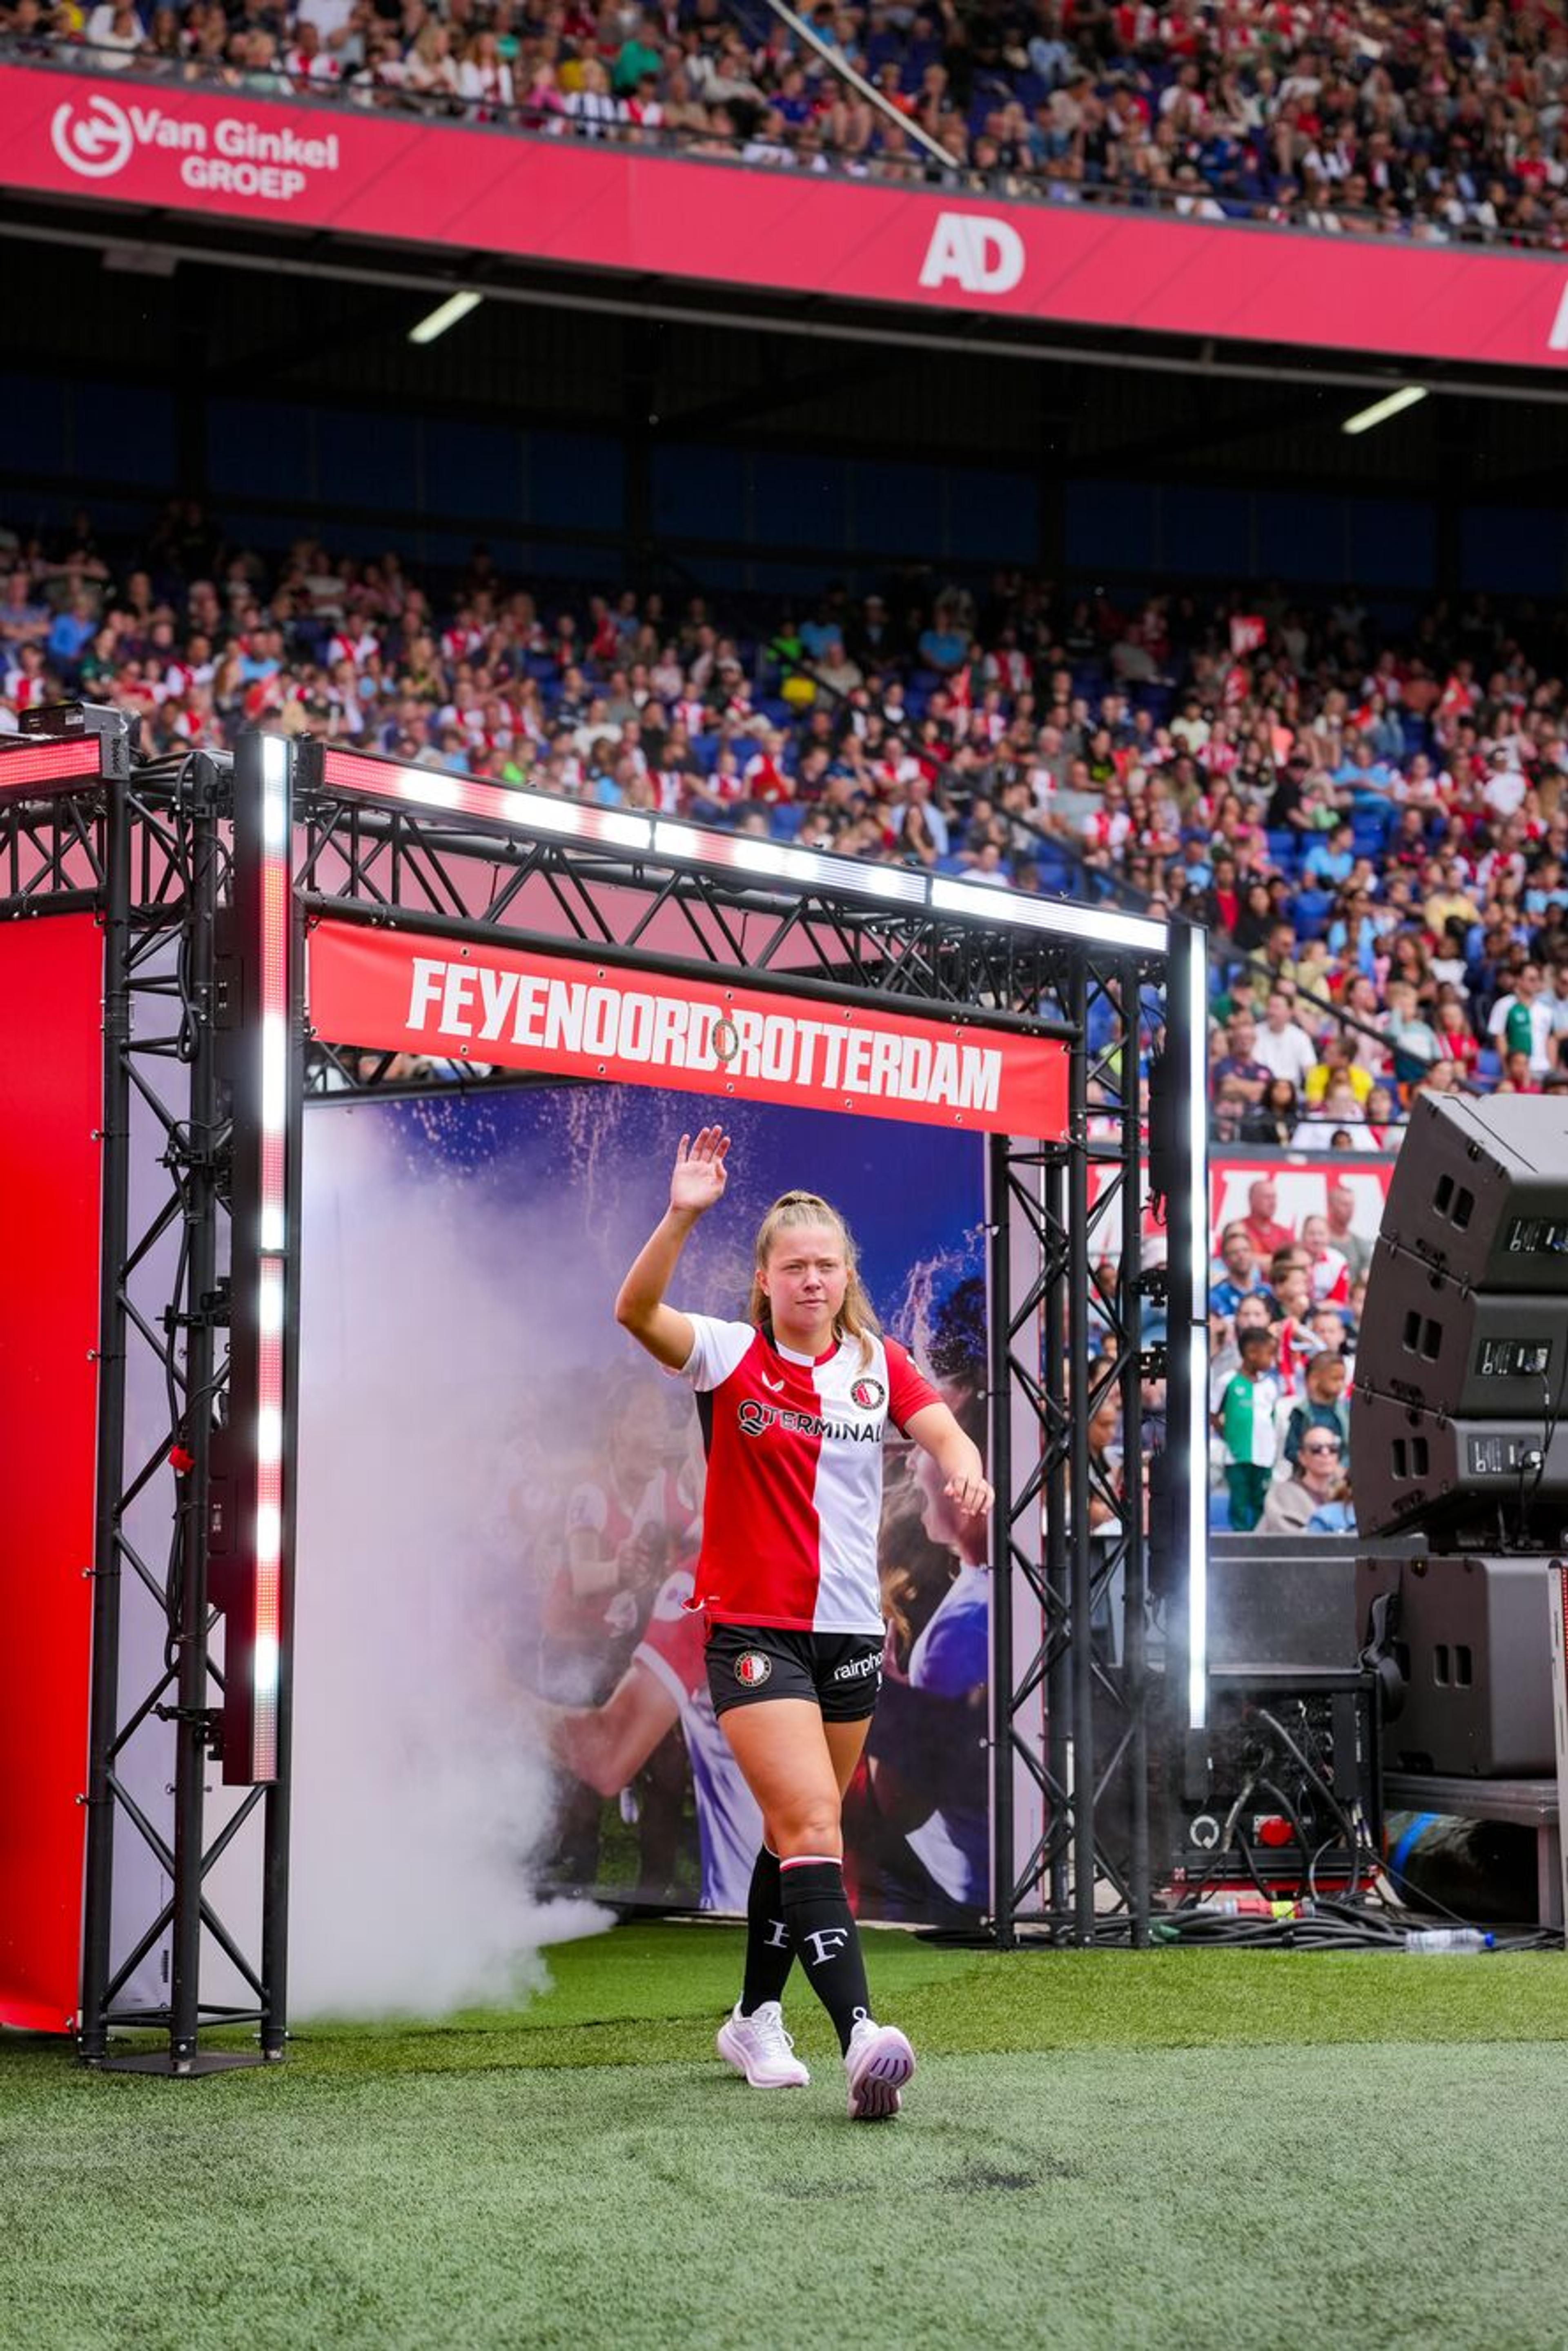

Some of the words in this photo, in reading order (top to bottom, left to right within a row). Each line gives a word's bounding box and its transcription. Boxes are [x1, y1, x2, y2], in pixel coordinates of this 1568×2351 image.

[129, 106, 206, 151] Van
[215, 118, 339, 170] Ginkel
[180, 156, 305, 200] GROEP
[918, 211, 1026, 294] AD
[406, 957, 722, 1072] FEYENOORD
[725, 1008, 1002, 1112] ROTTERDAM
[804, 1928, 848, 1966] F
